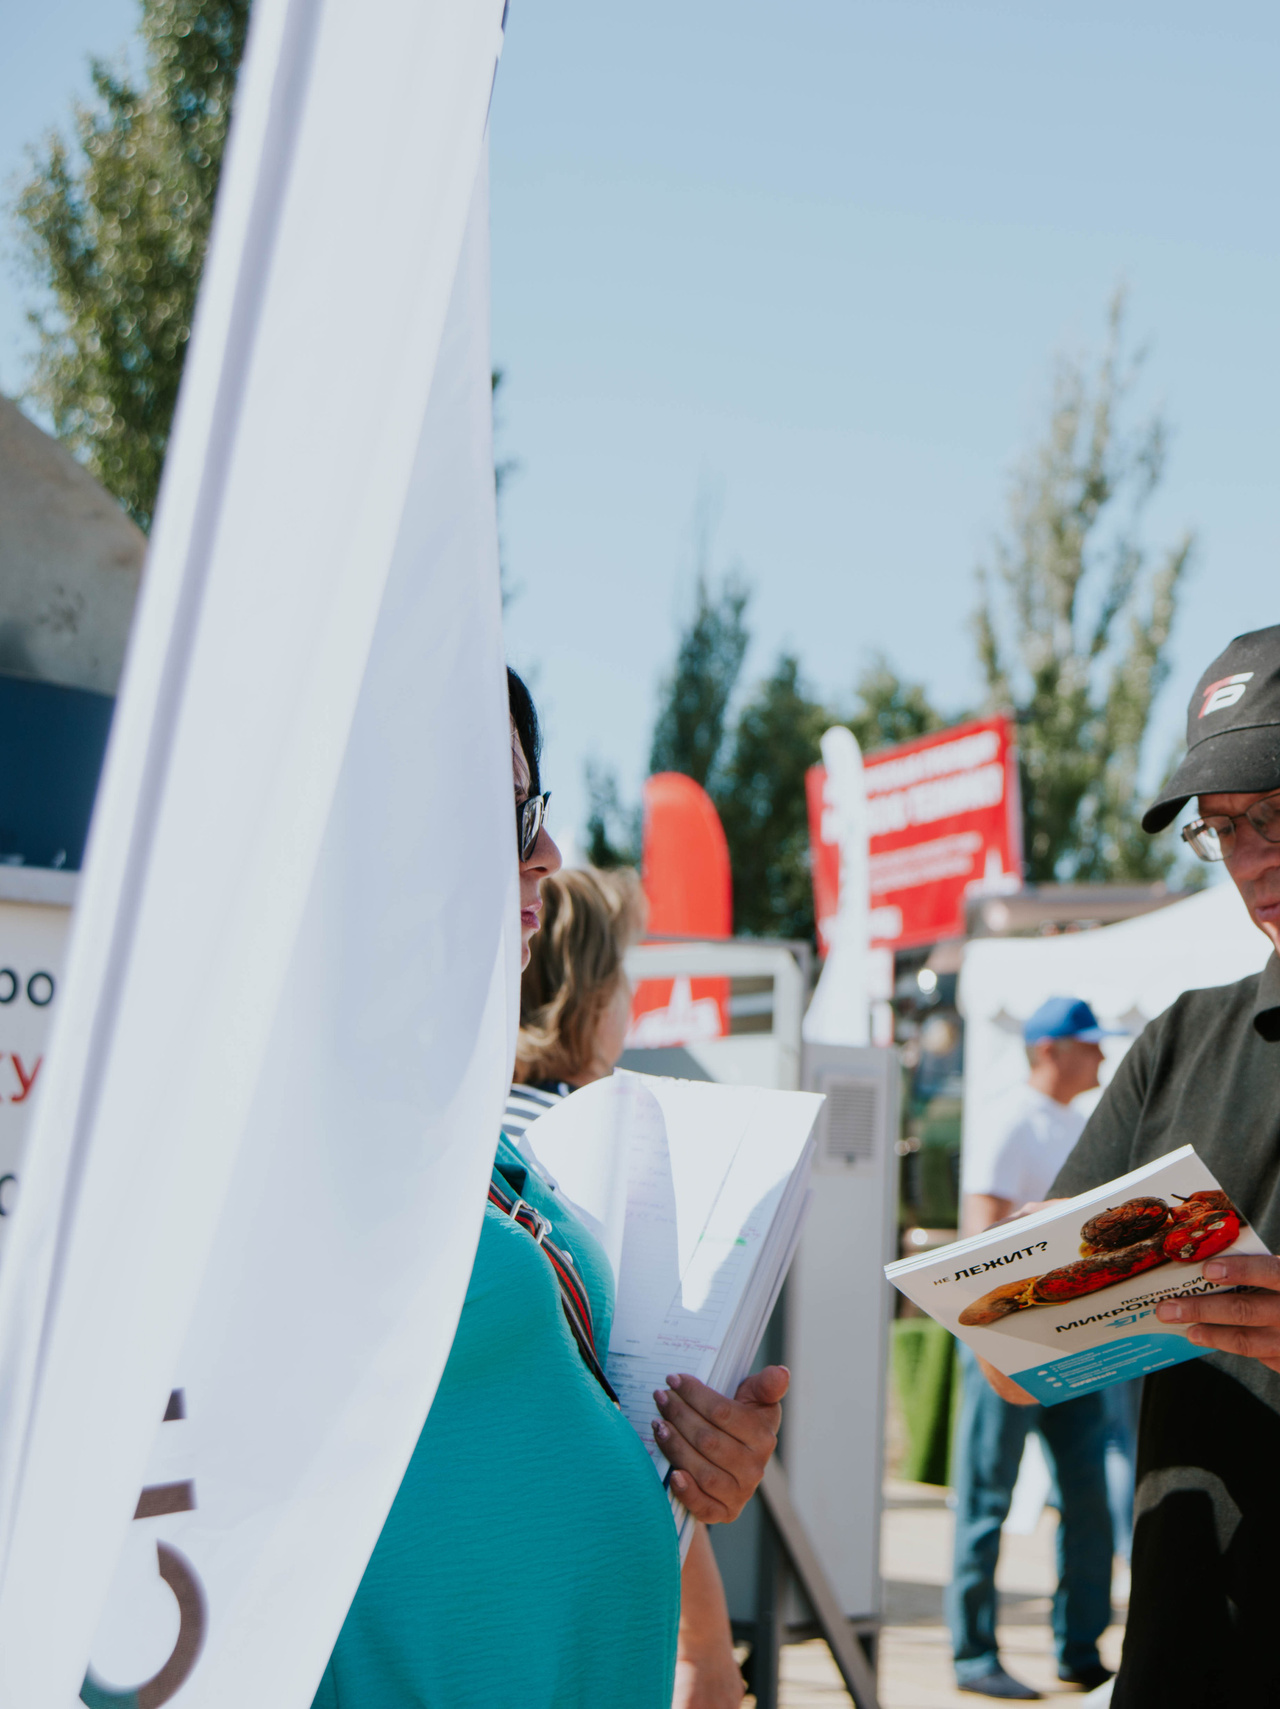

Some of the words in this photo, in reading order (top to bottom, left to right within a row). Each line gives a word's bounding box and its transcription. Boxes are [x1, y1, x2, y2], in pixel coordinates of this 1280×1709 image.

[933, 1276, 951, 1286] НЕ
[954, 1240, 1048, 1281] ЛЕЖИТ?
[1055, 1281, 1221, 1333] МИКРОКЛИМ
[1120, 1286, 1180, 1306] ПОСТАВЬ
[1182, 1275, 1206, 1289] СИ
